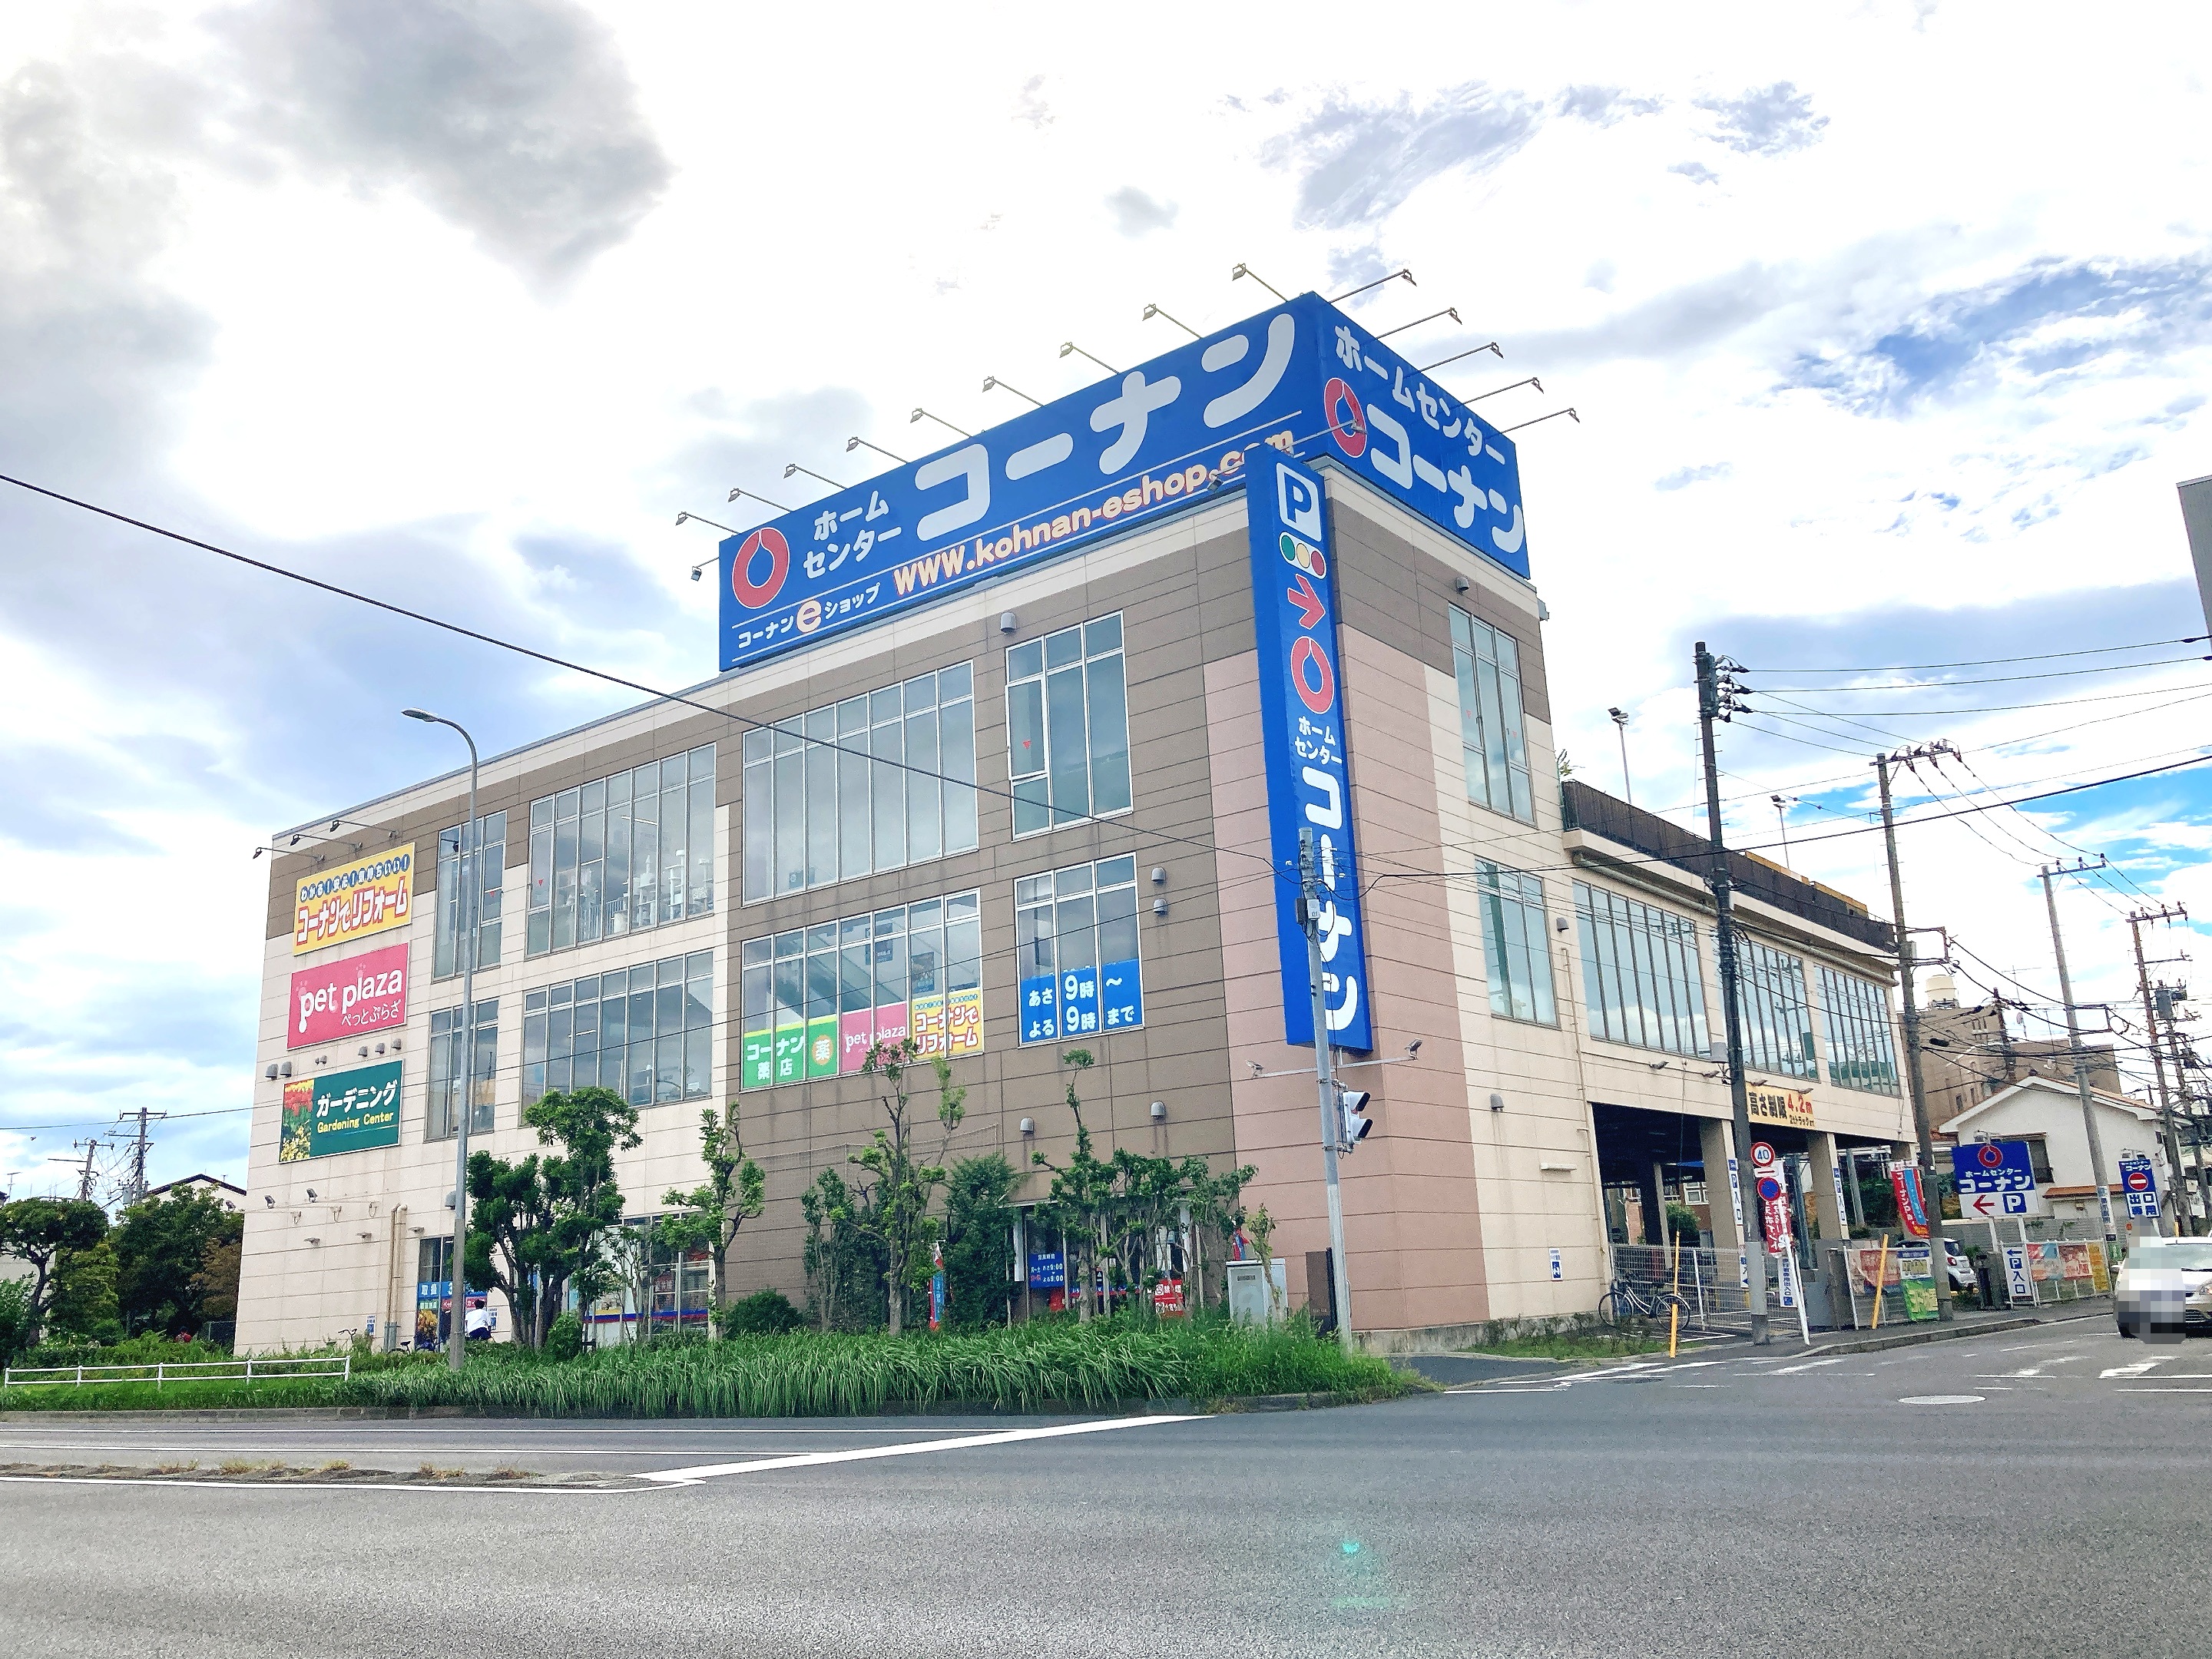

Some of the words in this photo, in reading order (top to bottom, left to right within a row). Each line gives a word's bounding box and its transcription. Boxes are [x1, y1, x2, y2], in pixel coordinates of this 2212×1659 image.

[1335, 326, 1505, 465] ホームセンター
[916, 313, 1296, 541] コーナン
[1366, 403, 1525, 554] コーナン
[1283, 472, 1312, 523] P
[813, 491, 889, 541] ホーム
[803, 527, 902, 579] センター
[1298, 716, 1336, 747] ホーム
[1294, 737, 1343, 767] センター
[296, 876, 409, 946] コーナンでリフォーム
[1302, 766, 1359, 1031] コーナン
[298, 982, 337, 1034] pet
[342, 969, 402, 1015] plaza
[1028, 988, 1053, 1007] あさ
[1065, 975, 1095, 1001] 9時
[1029, 1018, 1055, 1038] よる
[1066, 1005, 1096, 1032] 9時
[1107, 1005, 1135, 1025] まで
[747, 1035, 804, 1061] コーナン
[846, 1031, 866, 1054] pet
[316, 1078, 398, 1118] ガーデニング
[317, 1117, 360, 1134] Gardening
[363, 1111, 394, 1125] Center
[1757, 1149, 1770, 1160] 40
[1959, 1175, 2031, 1193] コーナン
[1965, 1167, 2022, 1178] ホームセンター
[2006, 1195, 2022, 1212] P
[2129, 1194, 2154, 1204] 出口
[2012, 1270, 2026, 1293] 入口
